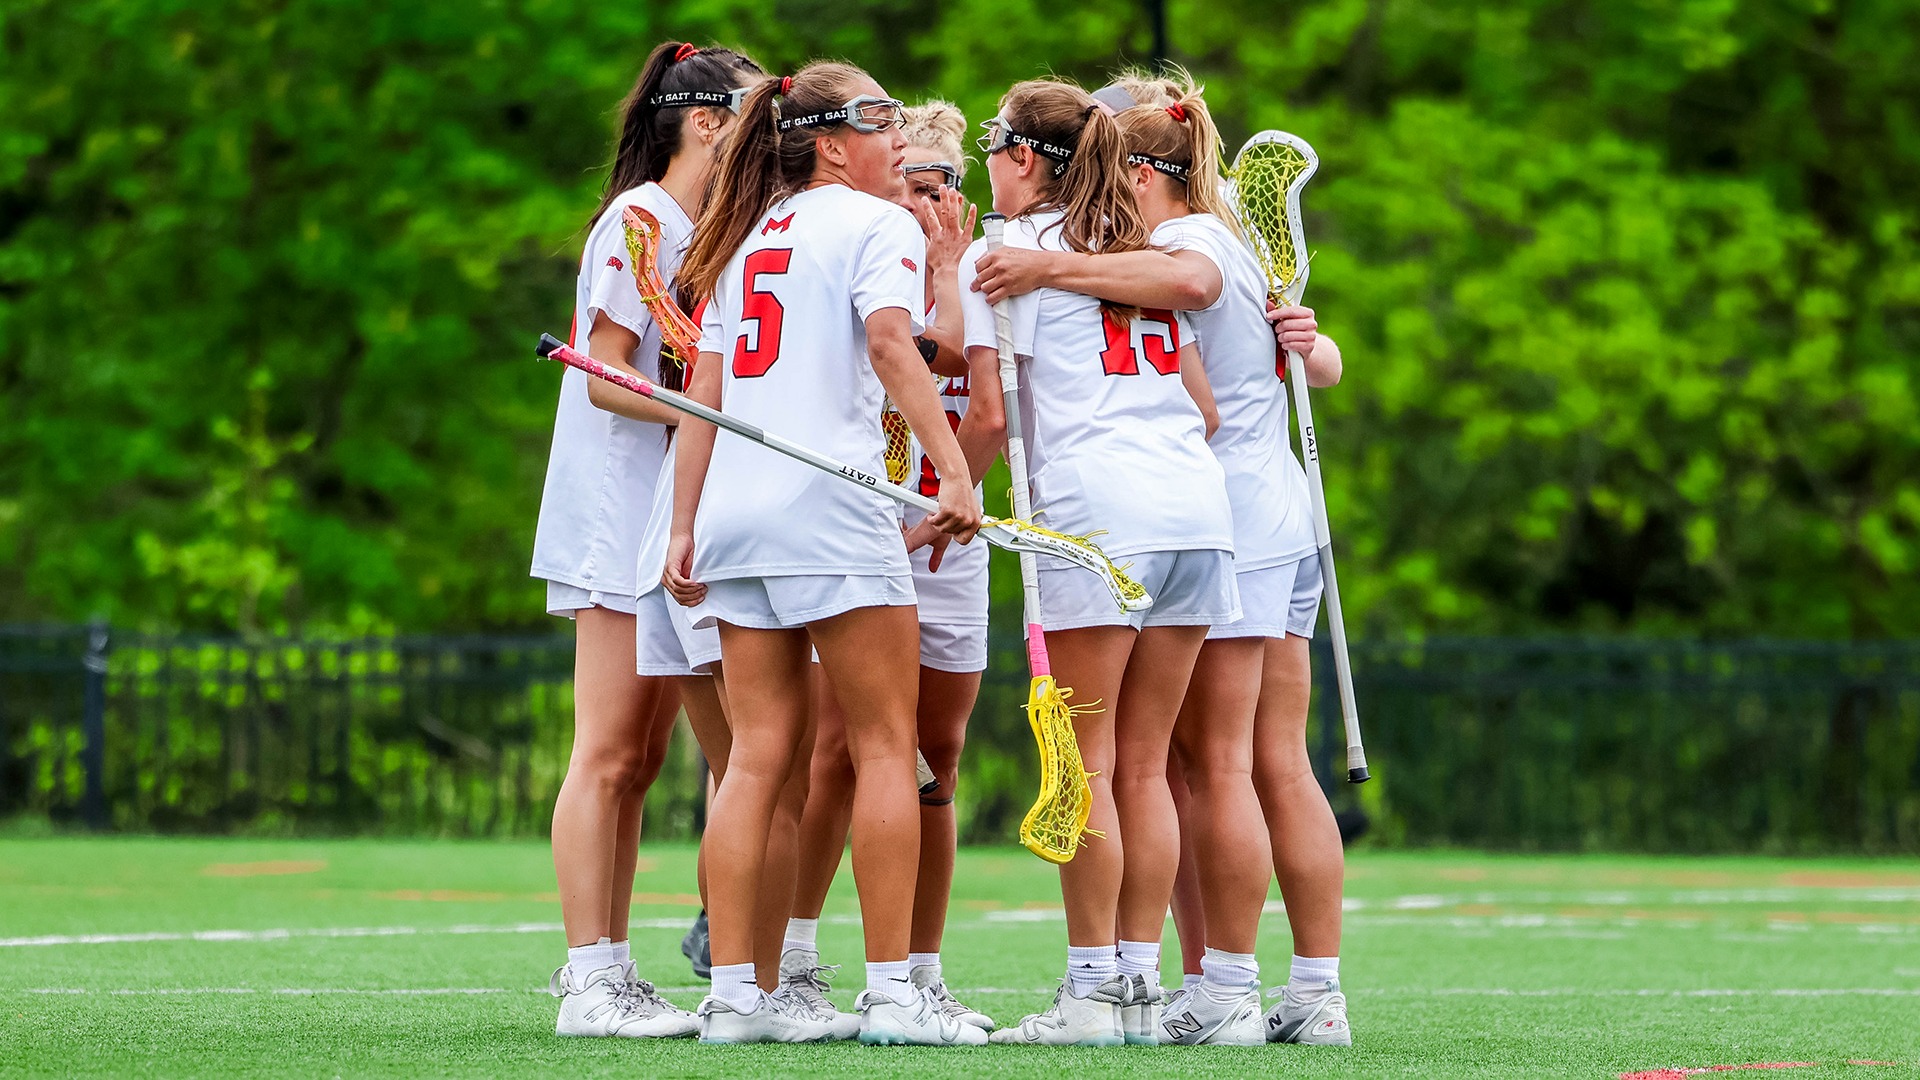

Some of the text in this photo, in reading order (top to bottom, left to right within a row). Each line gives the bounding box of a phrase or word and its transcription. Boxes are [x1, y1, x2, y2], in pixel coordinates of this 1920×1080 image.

[665, 92, 690, 102] GAIT
[695, 92, 726, 102] GAIT
[794, 114, 820, 126] GAIT
[825, 109, 847, 120] GAI
[1013, 134, 1072, 157] GAIT GAIT
[1127, 154, 1183, 174] AIT GAIT
[761, 211, 796, 237] M
[732, 247, 794, 379] 5
[1099, 307, 1181, 376] 15
[1306, 425, 1319, 464] GAIT
[838, 465, 877, 486] GAIT
